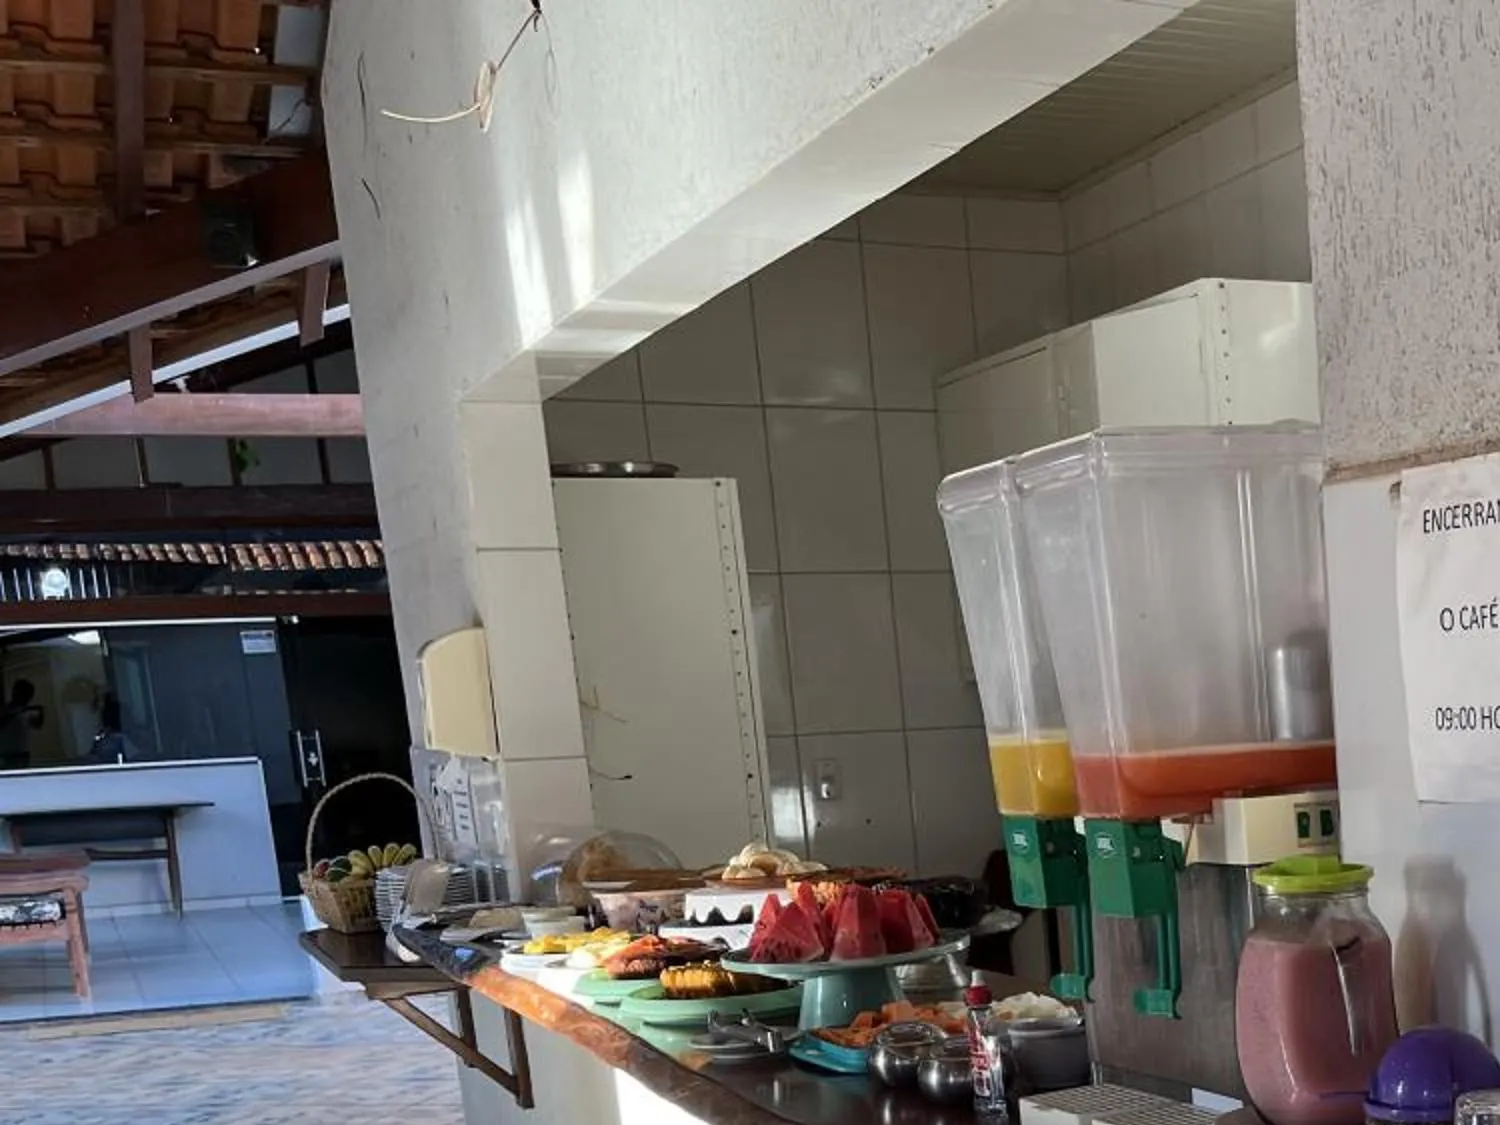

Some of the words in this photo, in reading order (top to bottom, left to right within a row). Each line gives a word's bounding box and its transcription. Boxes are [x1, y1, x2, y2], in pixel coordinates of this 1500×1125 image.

[1439, 607, 1455, 632] O
[1459, 597, 1499, 631] CAFÉ
[1435, 706, 1477, 731] 09:00
